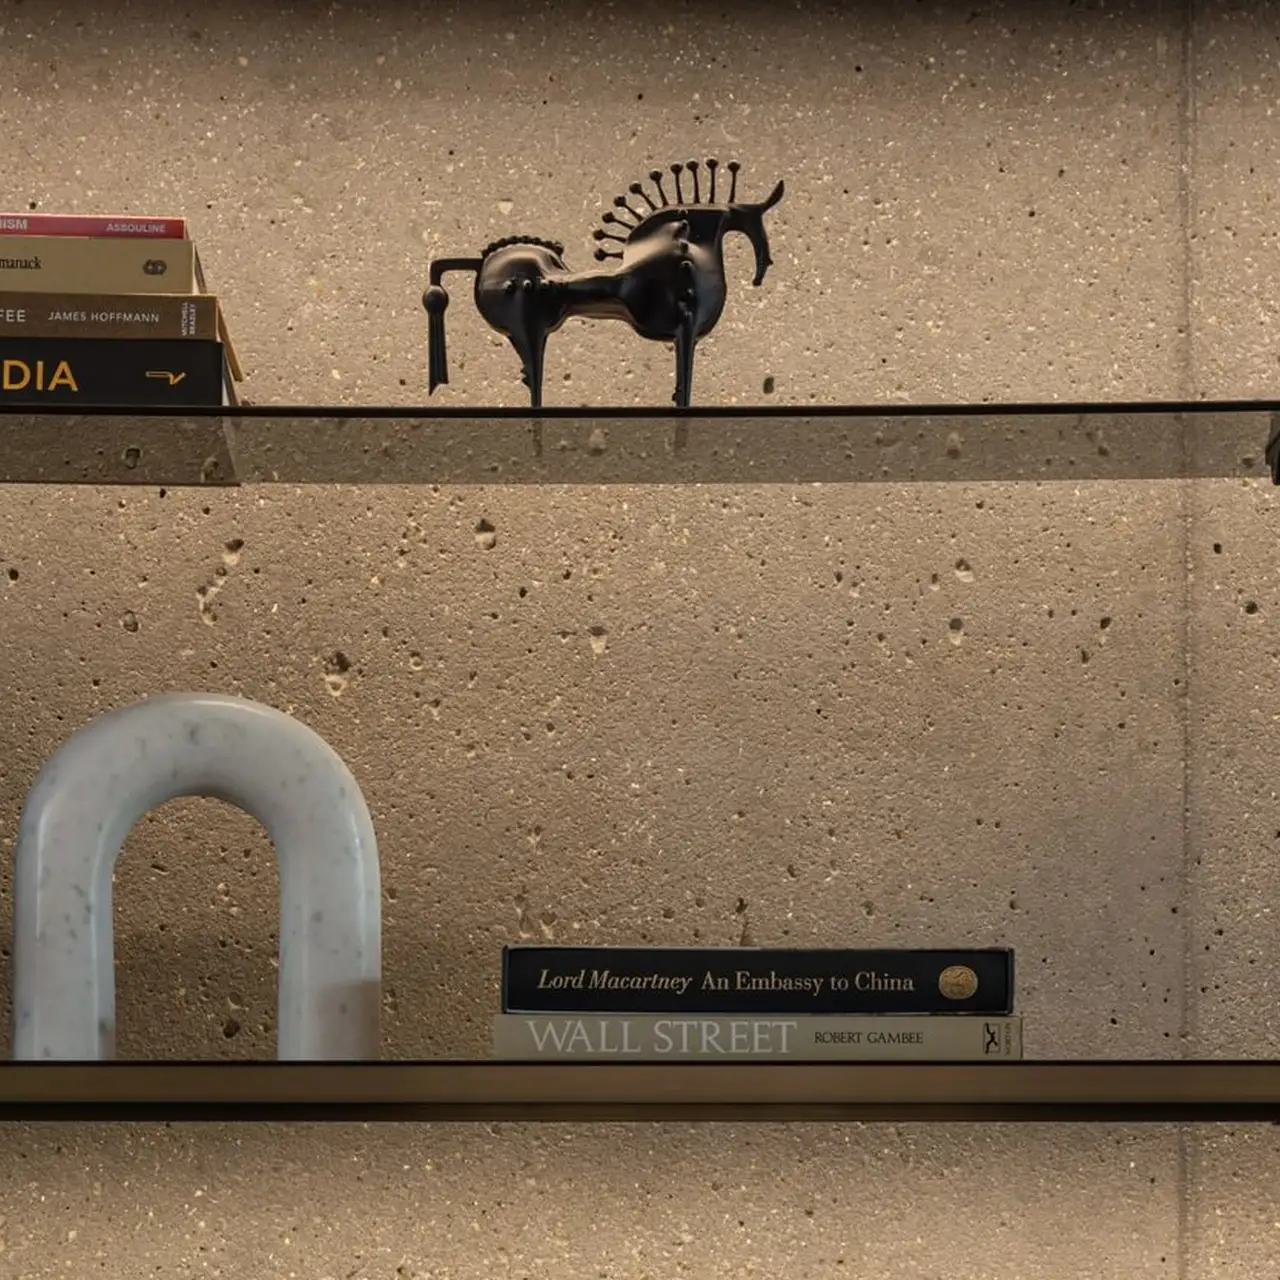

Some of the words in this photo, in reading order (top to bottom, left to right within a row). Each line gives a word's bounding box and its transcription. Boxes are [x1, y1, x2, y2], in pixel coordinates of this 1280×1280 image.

[105, 222, 166, 233] ASSOULINE
[47, 311, 87, 322] JAMES
[90, 311, 160, 324] HOFFMANN
[537, 968, 586, 989] Lord
[587, 969, 693, 994] Macartney
[700, 970, 729, 990] An
[735, 970, 824, 996] Embassy
[830, 975, 849, 991] to
[854, 971, 916, 992] China
[525, 1019, 642, 1054] WALL
[653, 1019, 798, 1055] STREET
[814, 1031, 863, 1045] ROBERT
[866, 1031, 924, 1046] GAMBEE
